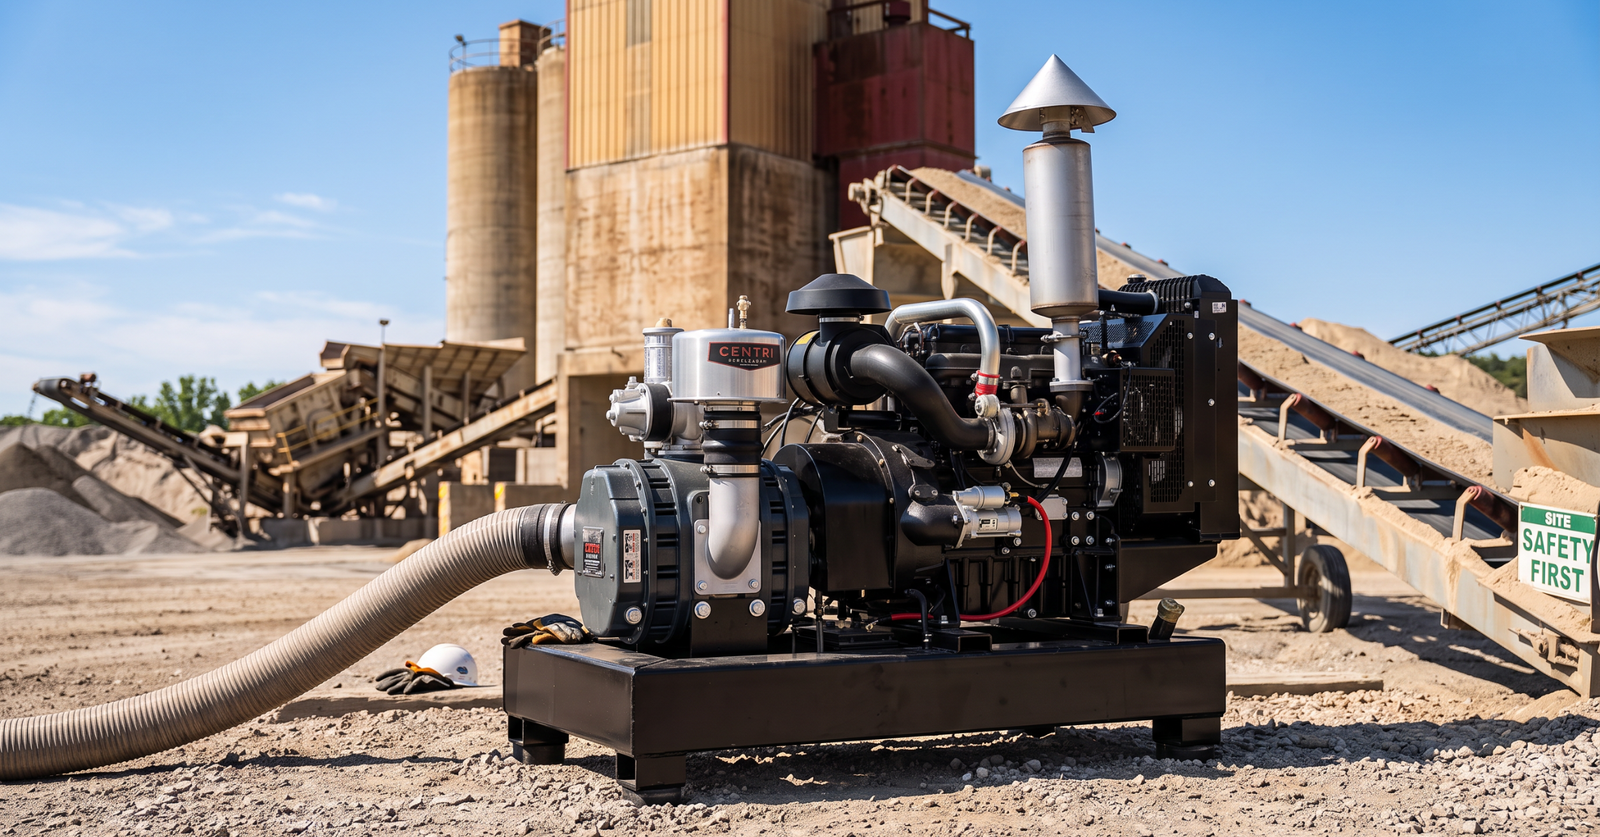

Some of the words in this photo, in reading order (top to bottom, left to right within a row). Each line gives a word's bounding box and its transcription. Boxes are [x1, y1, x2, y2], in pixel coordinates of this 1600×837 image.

[719, 346, 774, 358] CENTRI
[1545, 512, 1571, 528] SITE
[1523, 528, 1594, 564] SAFETY
[1531, 559, 1584, 592] FIRST
